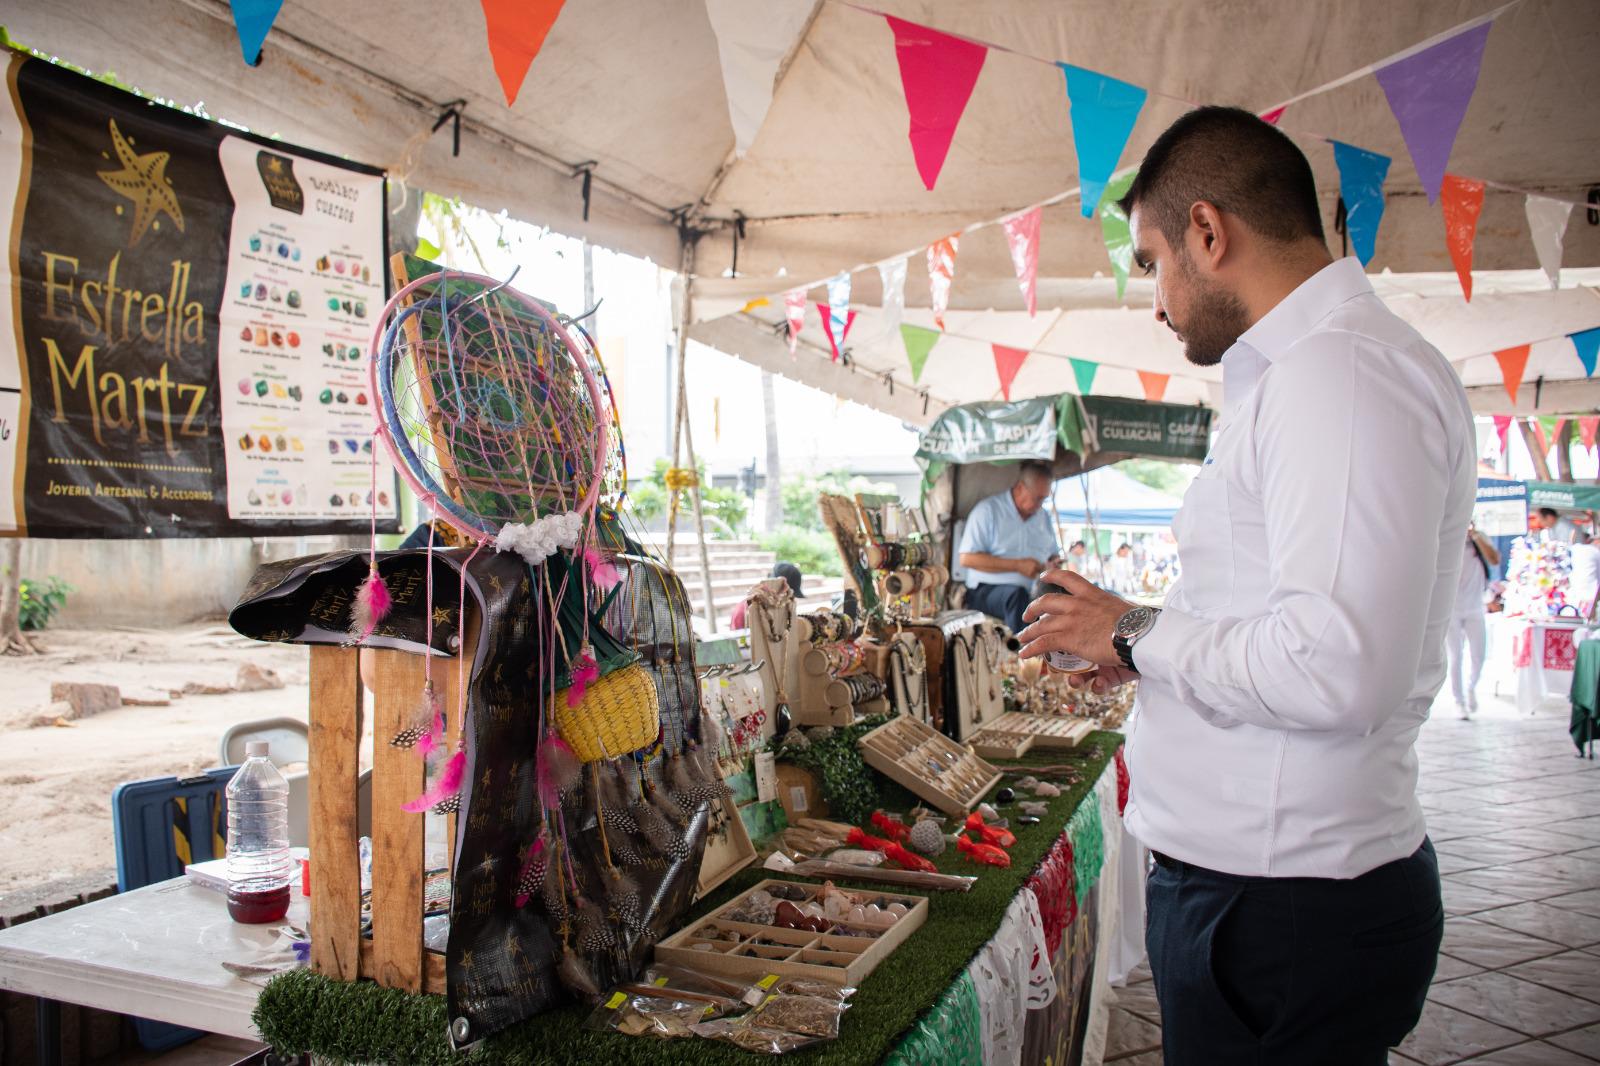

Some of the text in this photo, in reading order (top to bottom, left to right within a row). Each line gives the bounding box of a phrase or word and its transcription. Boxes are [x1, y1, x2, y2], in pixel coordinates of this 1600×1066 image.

[41, 250, 207, 360] Estrella
[40, 337, 208, 457] Martz
[150, 484, 159, 499] &
